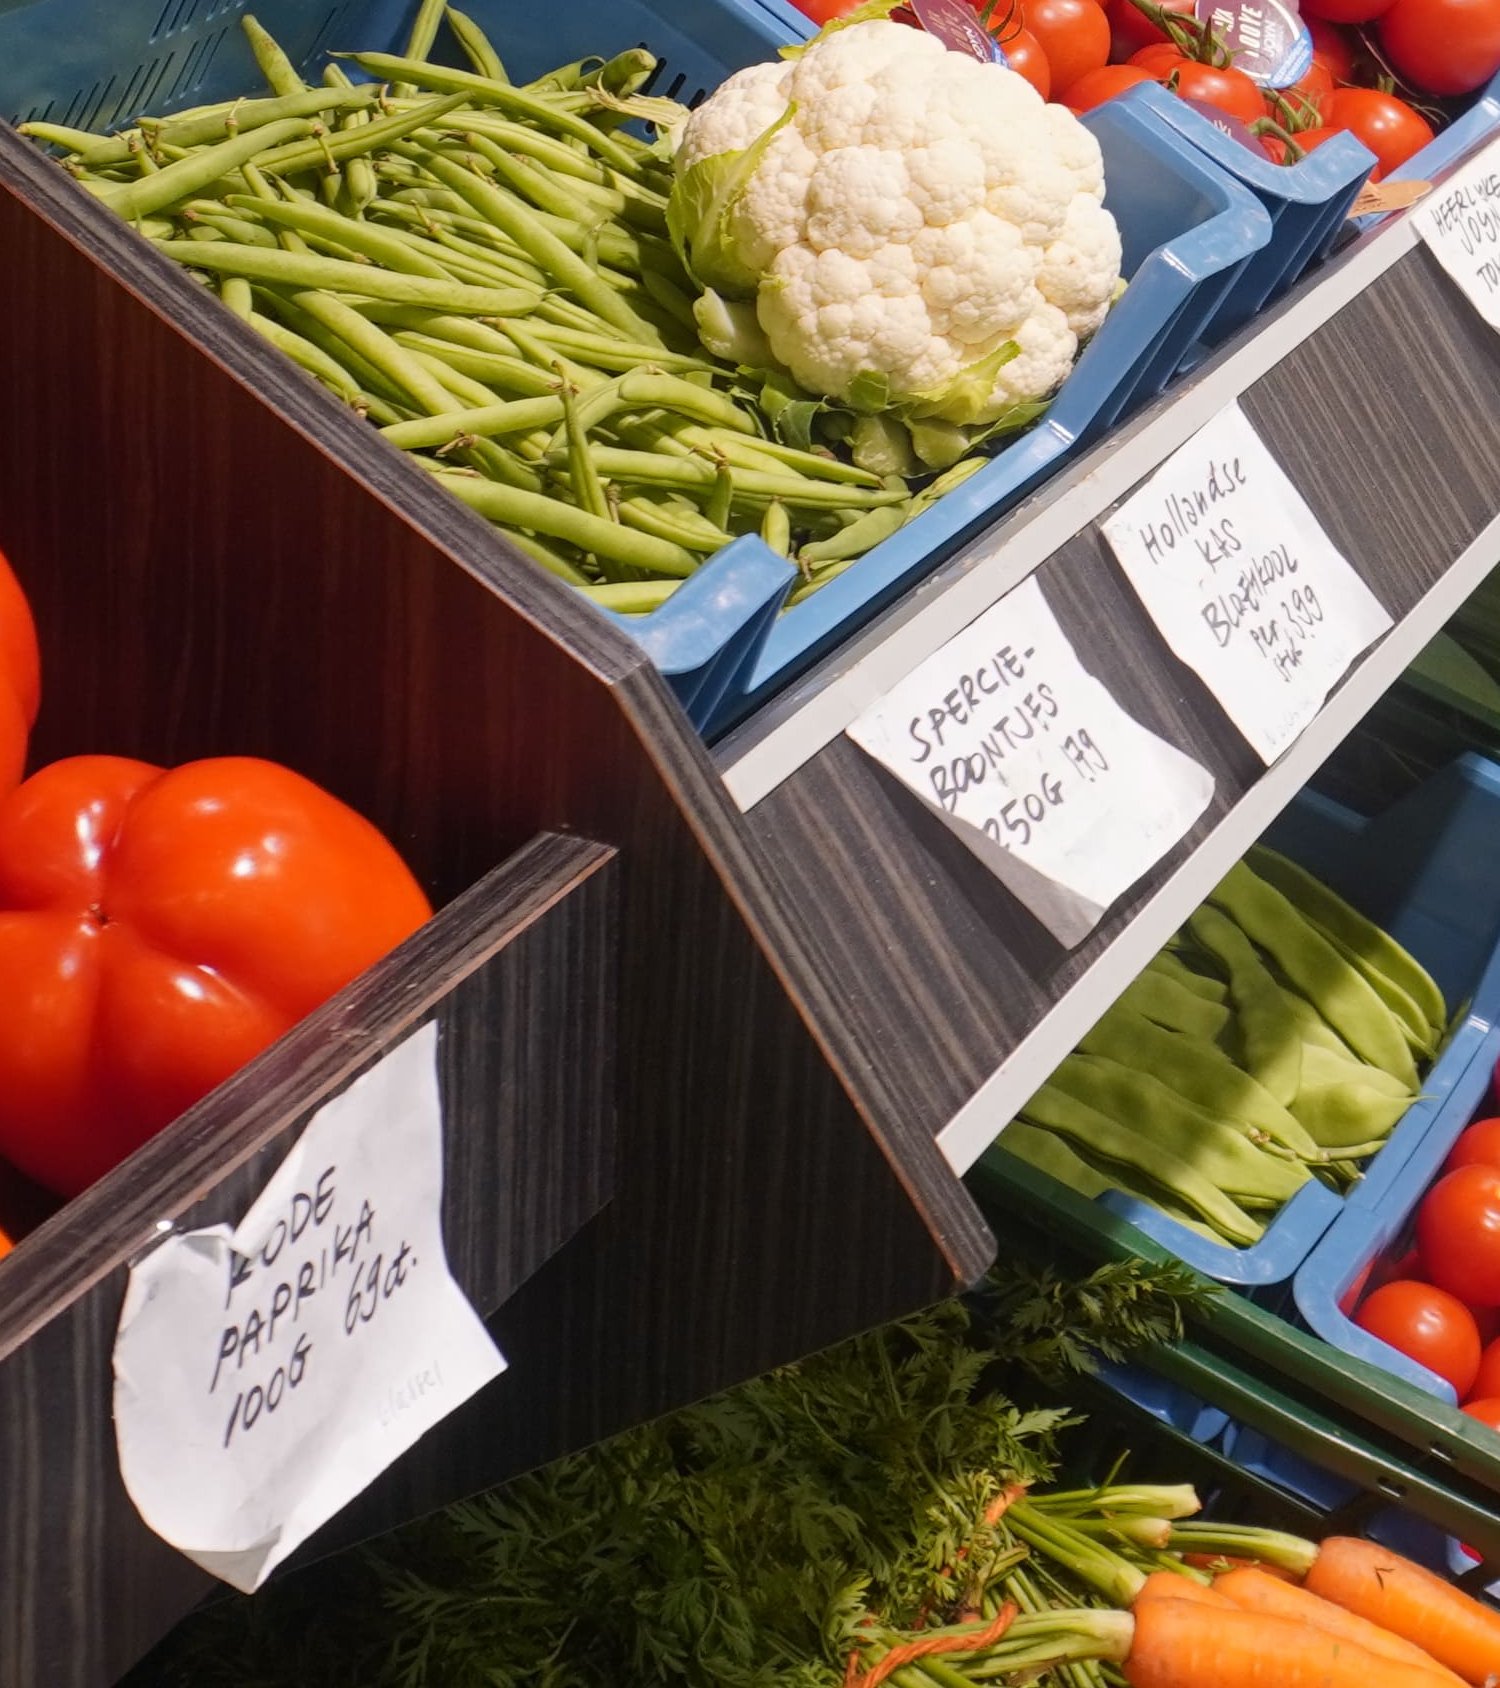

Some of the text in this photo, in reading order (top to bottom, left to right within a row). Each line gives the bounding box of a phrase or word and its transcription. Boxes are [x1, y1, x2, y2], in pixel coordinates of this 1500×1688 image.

[1139, 457, 1247, 565] Hollandse
[1194, 518, 1242, 574] KAS
[909, 645, 1035, 763] SPERCIE-
[929, 682, 1059, 814] BOONTJES
[209, 1199, 376, 1394] PAPRIKA
[223, 1332, 313, 1449] 100G
